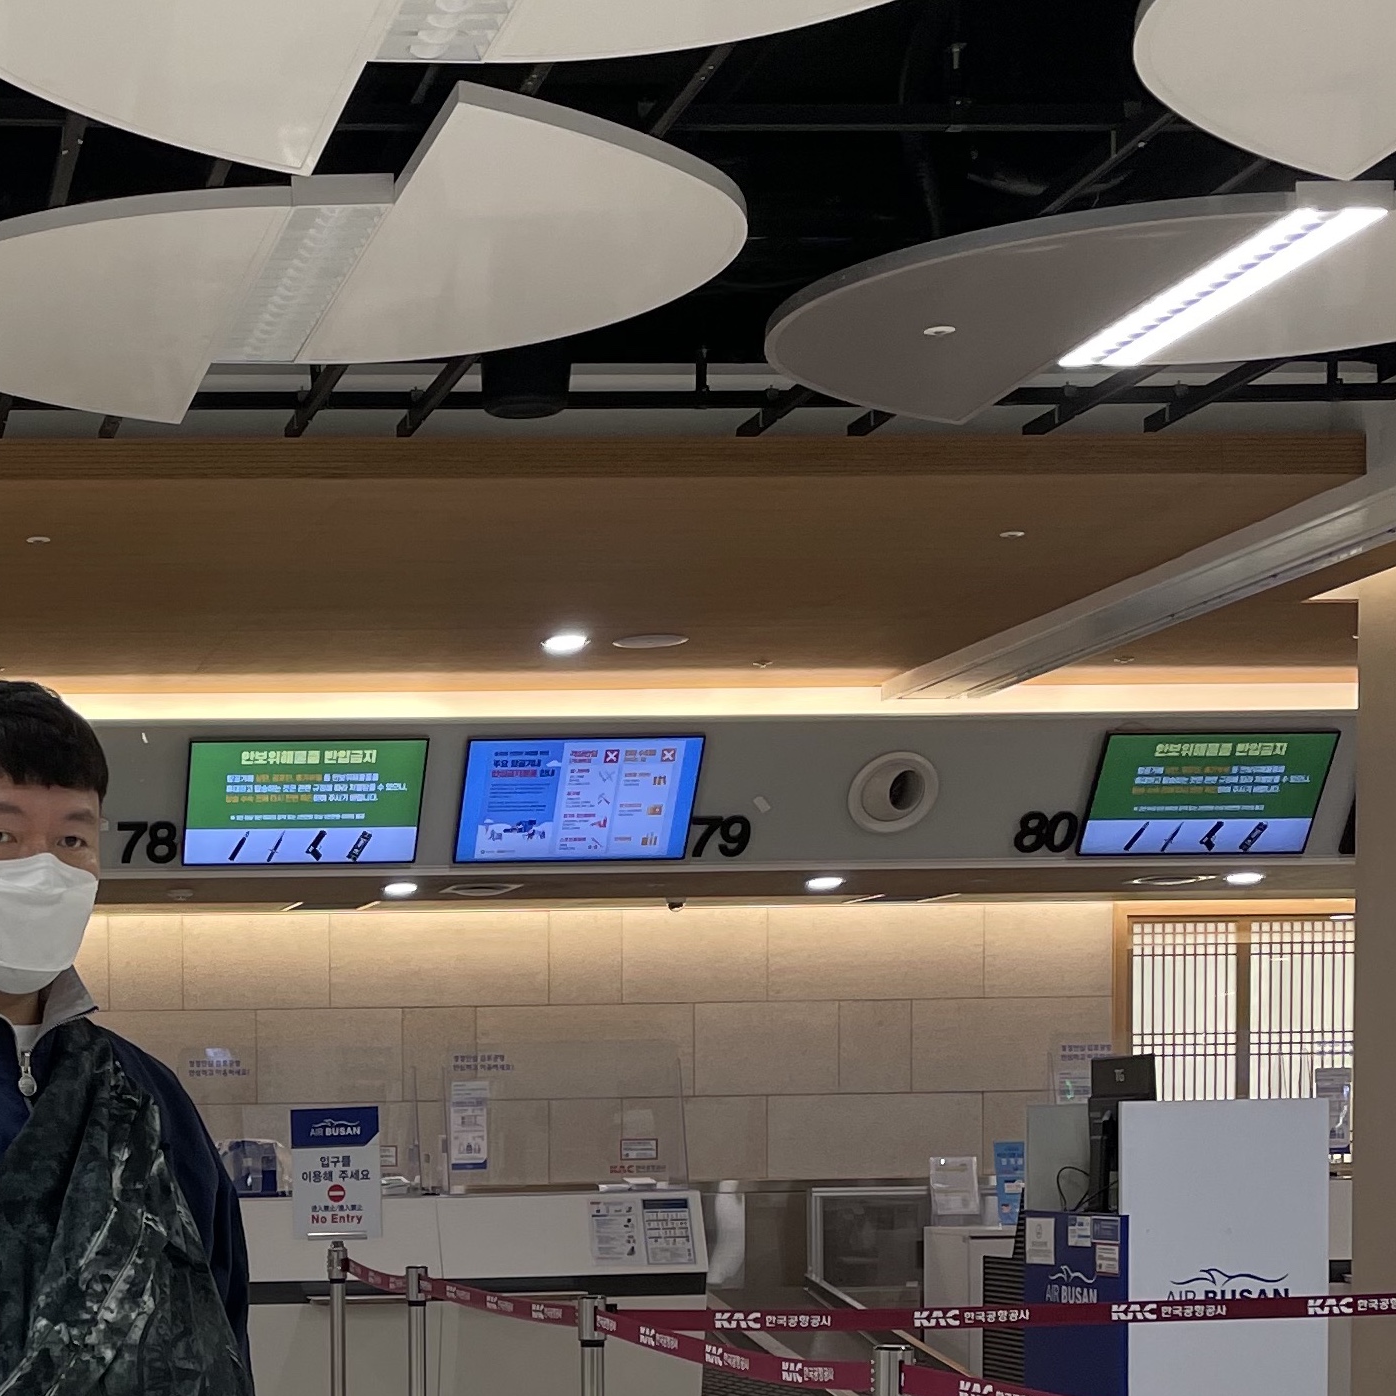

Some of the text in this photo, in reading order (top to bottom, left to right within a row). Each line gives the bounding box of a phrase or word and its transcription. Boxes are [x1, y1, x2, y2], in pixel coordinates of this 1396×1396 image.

[324, 749, 378, 764] 반입금지
[691, 816, 752, 859] 79
[1013, 811, 1079, 855] 80
[117, 821, 178, 866] 78
[325, 1126, 361, 1136] BUSAN
[319, 1155, 351, 1168] 입구를
[301, 1169, 371, 1183] 이용해 주세요
[311, 1213, 363, 1225] No Entry
[1044, 1285, 1098, 1304] AIR BUSAN
[1111, 1303, 1227, 1321] KAC 한국공항공사
[1307, 1297, 1354, 1316] KAC
[715, 1312, 832, 1329] KAC 한국공항공사
[913, 1309, 1030, 1327] KAC 한국공항공사
